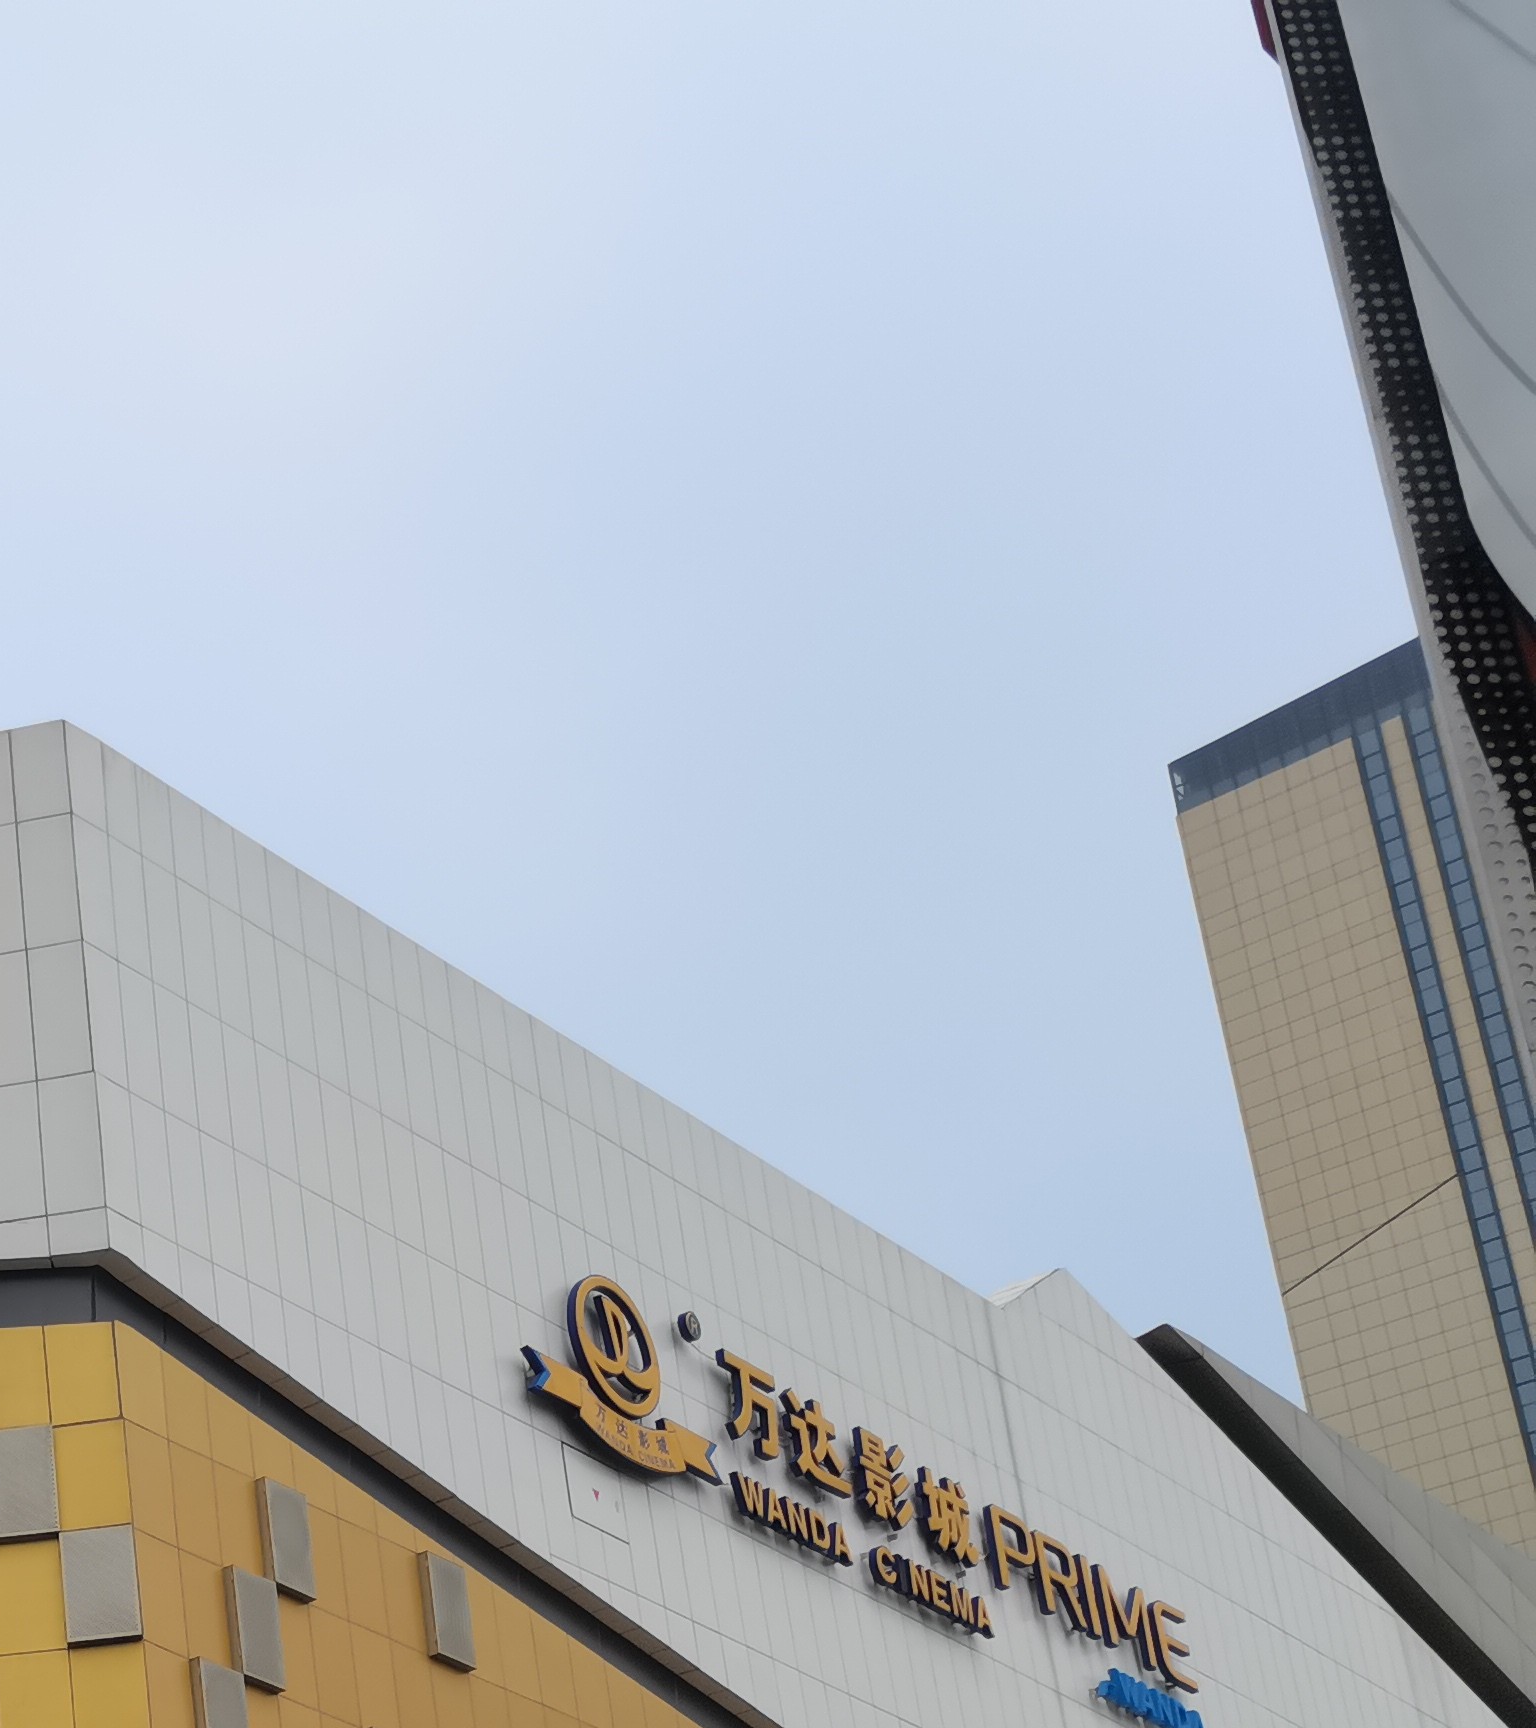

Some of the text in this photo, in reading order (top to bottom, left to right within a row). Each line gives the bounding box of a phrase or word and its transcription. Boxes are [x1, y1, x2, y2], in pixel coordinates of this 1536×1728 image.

[715, 1348, 980, 1568] 万达影城
[729, 1470, 995, 1639] WANDA CINEMA
[983, 1504, 1200, 1694] PRIME
